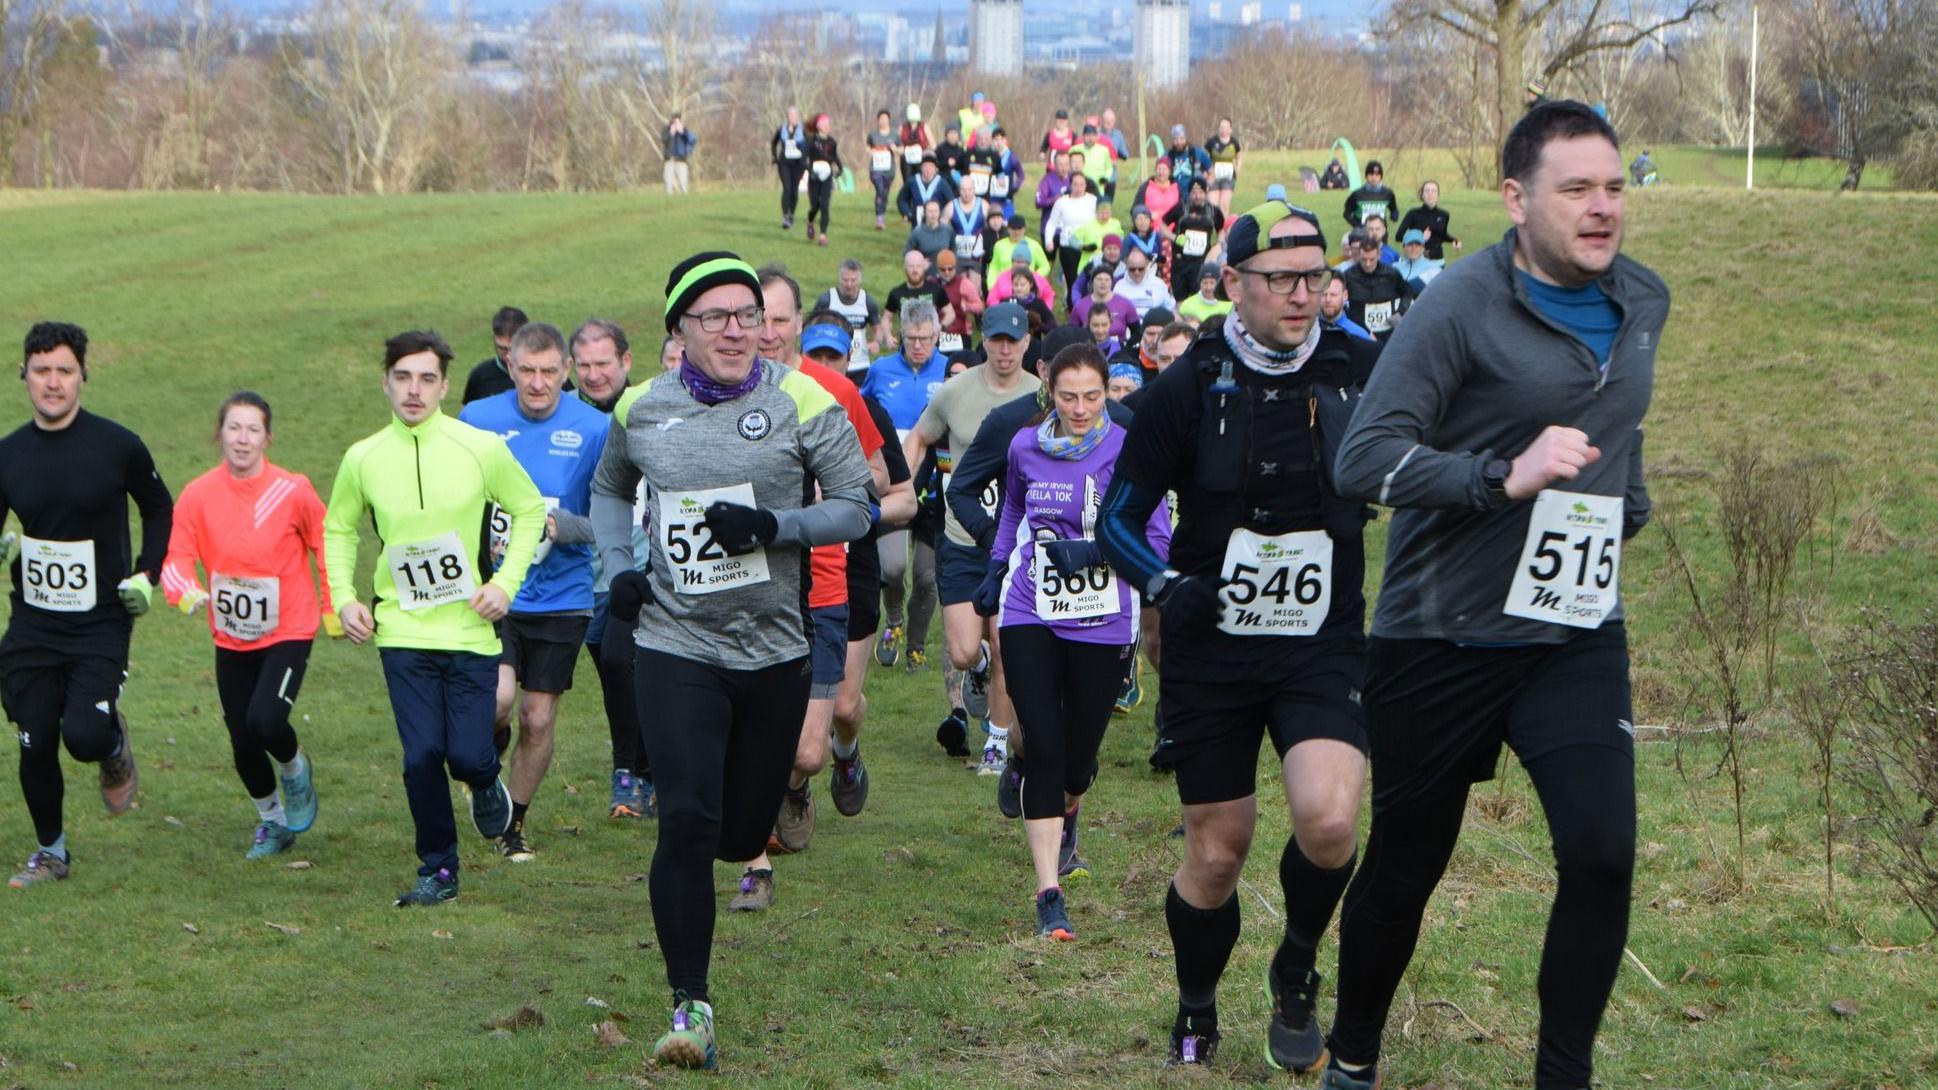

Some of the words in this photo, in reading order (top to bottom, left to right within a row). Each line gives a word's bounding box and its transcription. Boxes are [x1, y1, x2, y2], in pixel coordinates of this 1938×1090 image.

[1367, 311, 1388, 323] 591
[1050, 482, 1074, 491] IRVINE
[1055, 491, 1073, 502] 10K
[667, 521, 724, 565] 52
[1528, 530, 1615, 589] 515
[397, 554, 463, 587] 118
[713, 561, 741, 573] MIGO
[27, 559, 88, 590] 503
[708, 569, 750, 585] SPORTS
[435, 582, 457, 592] MIGO
[1227, 562, 1322, 605] 546
[433, 588, 463, 600] SPORTS
[1077, 595, 1099, 603] MIGO
[216, 589, 267, 622] 501
[1074, 602, 1105, 613] SPORTS
[1273, 609, 1304, 617] MIGO
[1264, 619, 1308, 628] SPORTS
